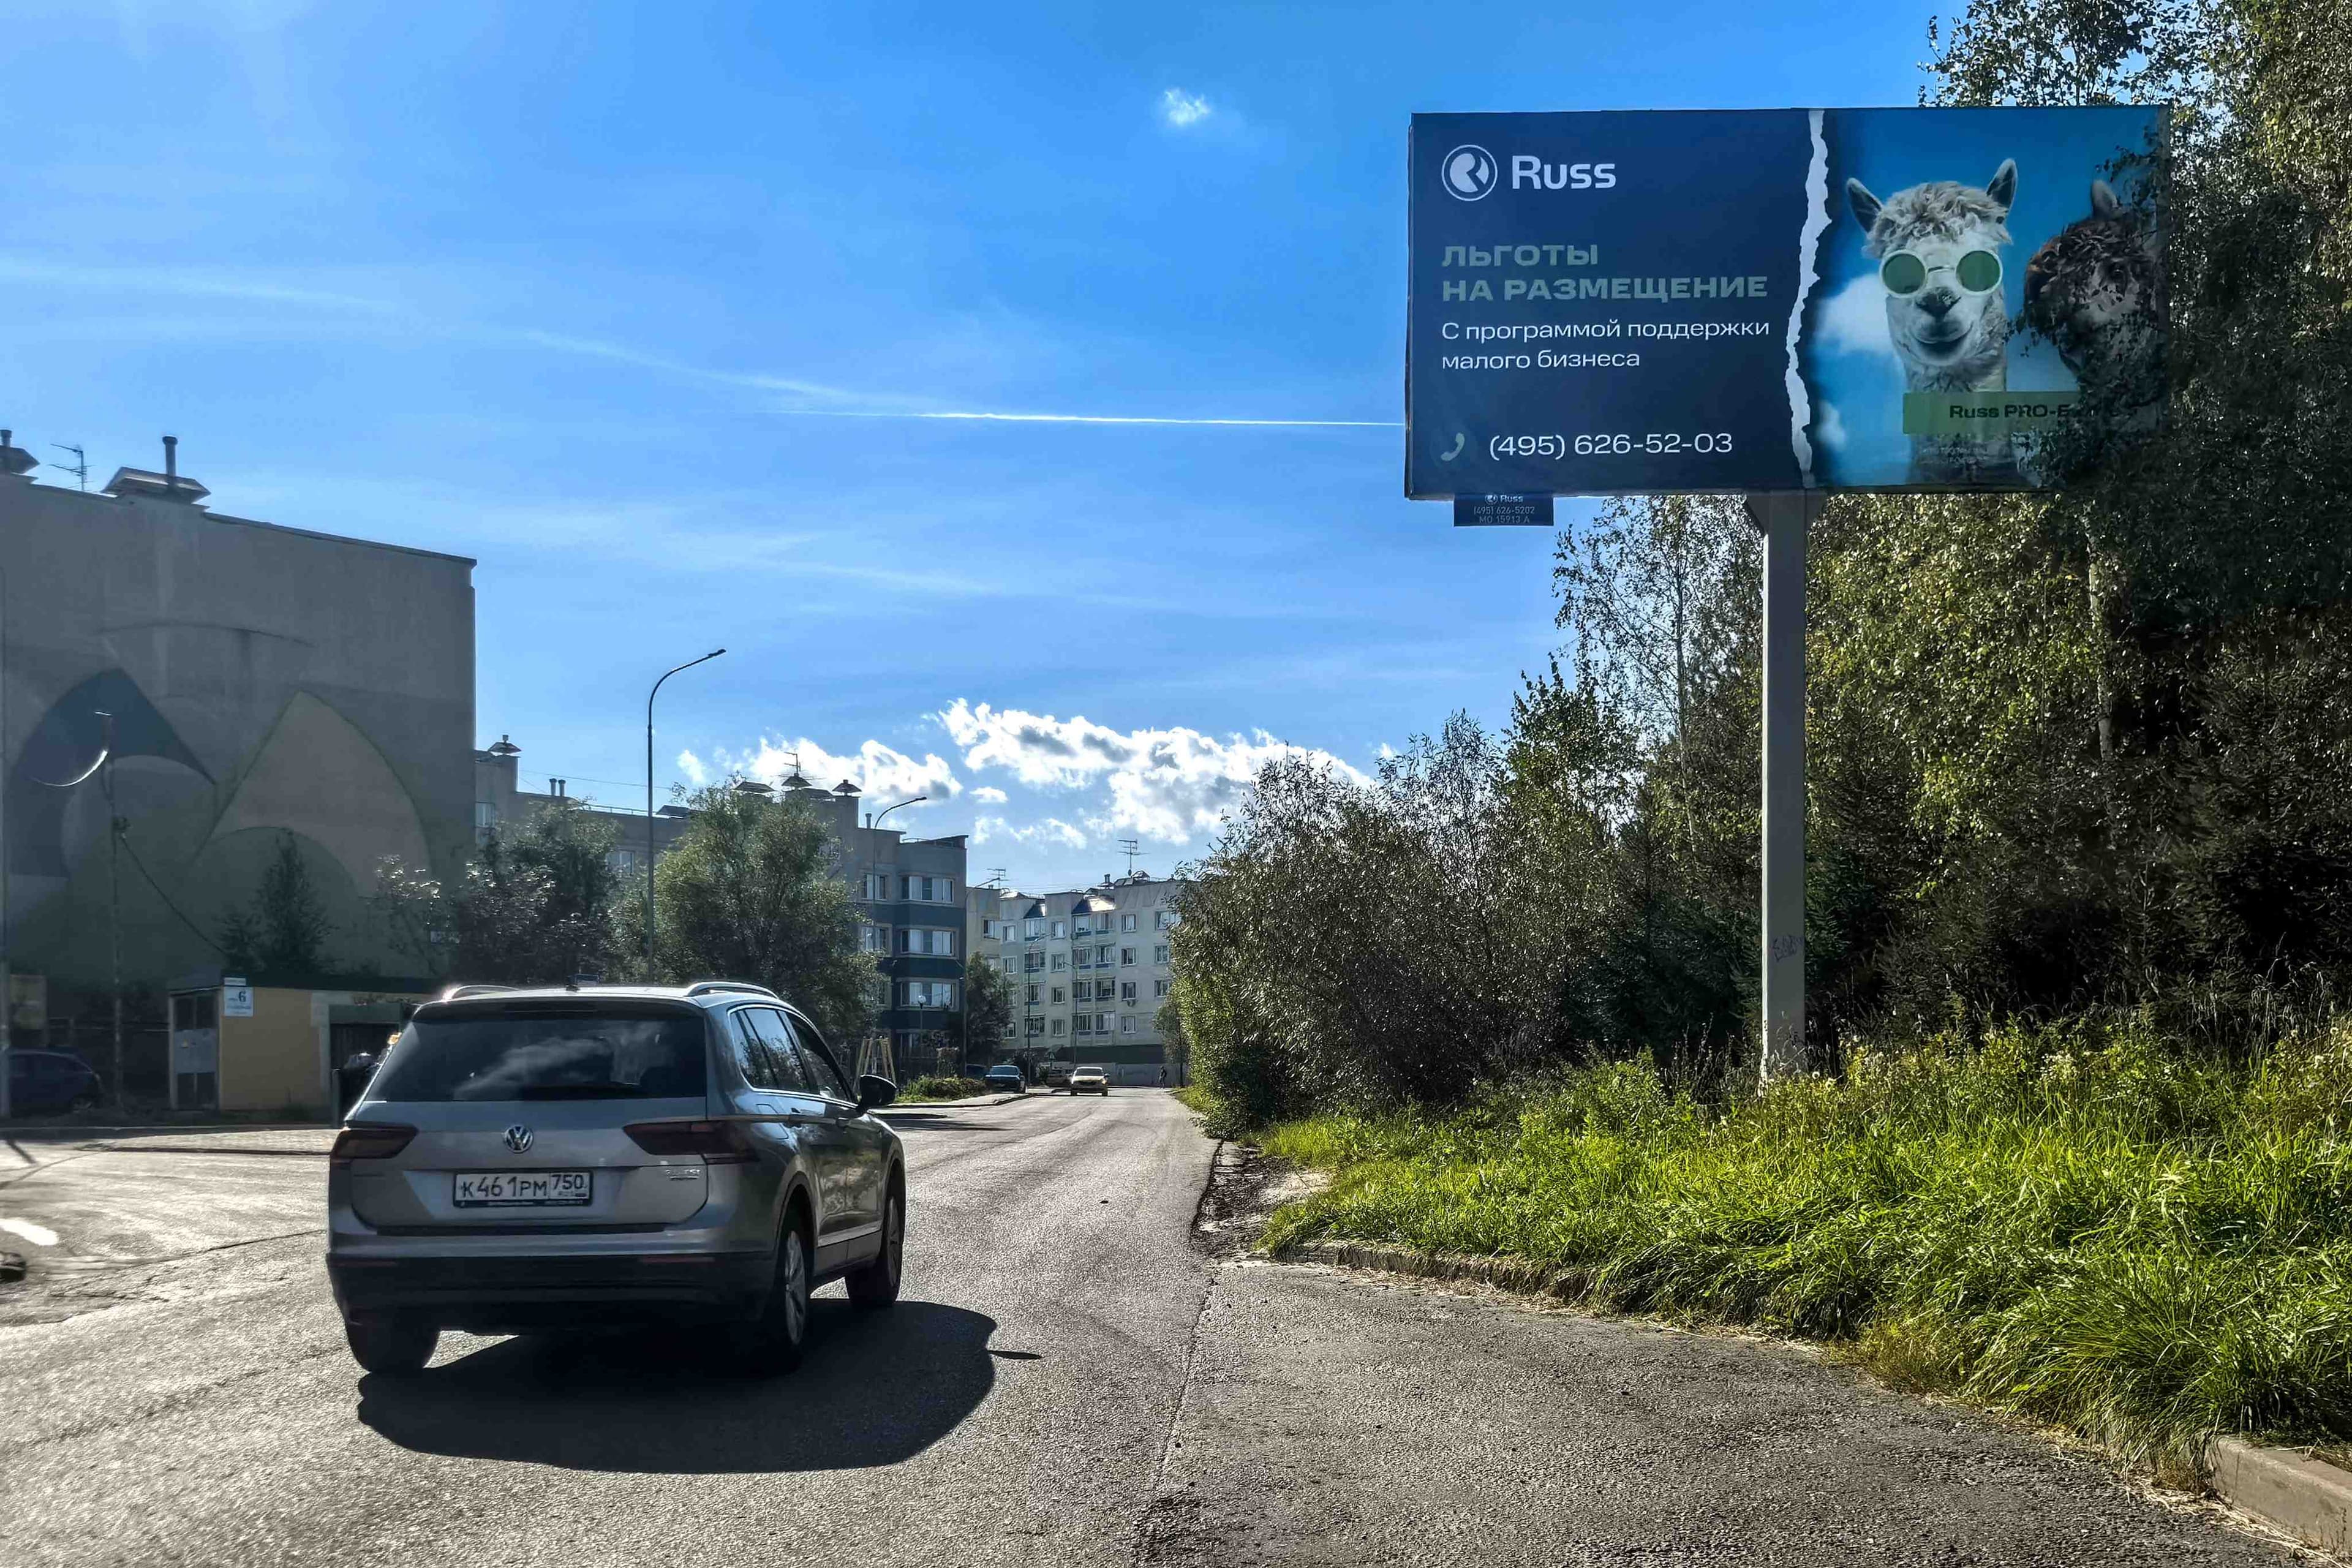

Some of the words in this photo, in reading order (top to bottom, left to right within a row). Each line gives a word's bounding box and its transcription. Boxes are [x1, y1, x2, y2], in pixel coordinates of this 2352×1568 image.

[1512, 155, 1617, 190] Russ
[1442, 244, 1598, 267] ЛЬГОТЫ
[1442, 279, 1493, 301] НА
[1504, 276, 1768, 303] РАЗМЕЩЕНИЕ
[1442, 322, 1460, 339] С
[1466, 318, 1621, 344] программой
[1627, 322, 1770, 341] поддержки
[1442, 355, 1531, 369] малого
[1537, 349, 1640, 368] бизнеса
[1949, 405, 1999, 418] Russ
[1490, 434, 1566, 461] (495)
[1574, 432, 1733, 455] 626-52-03
[1500, 494, 1523, 503] Russ
[552, 1174, 584, 1189] 750
